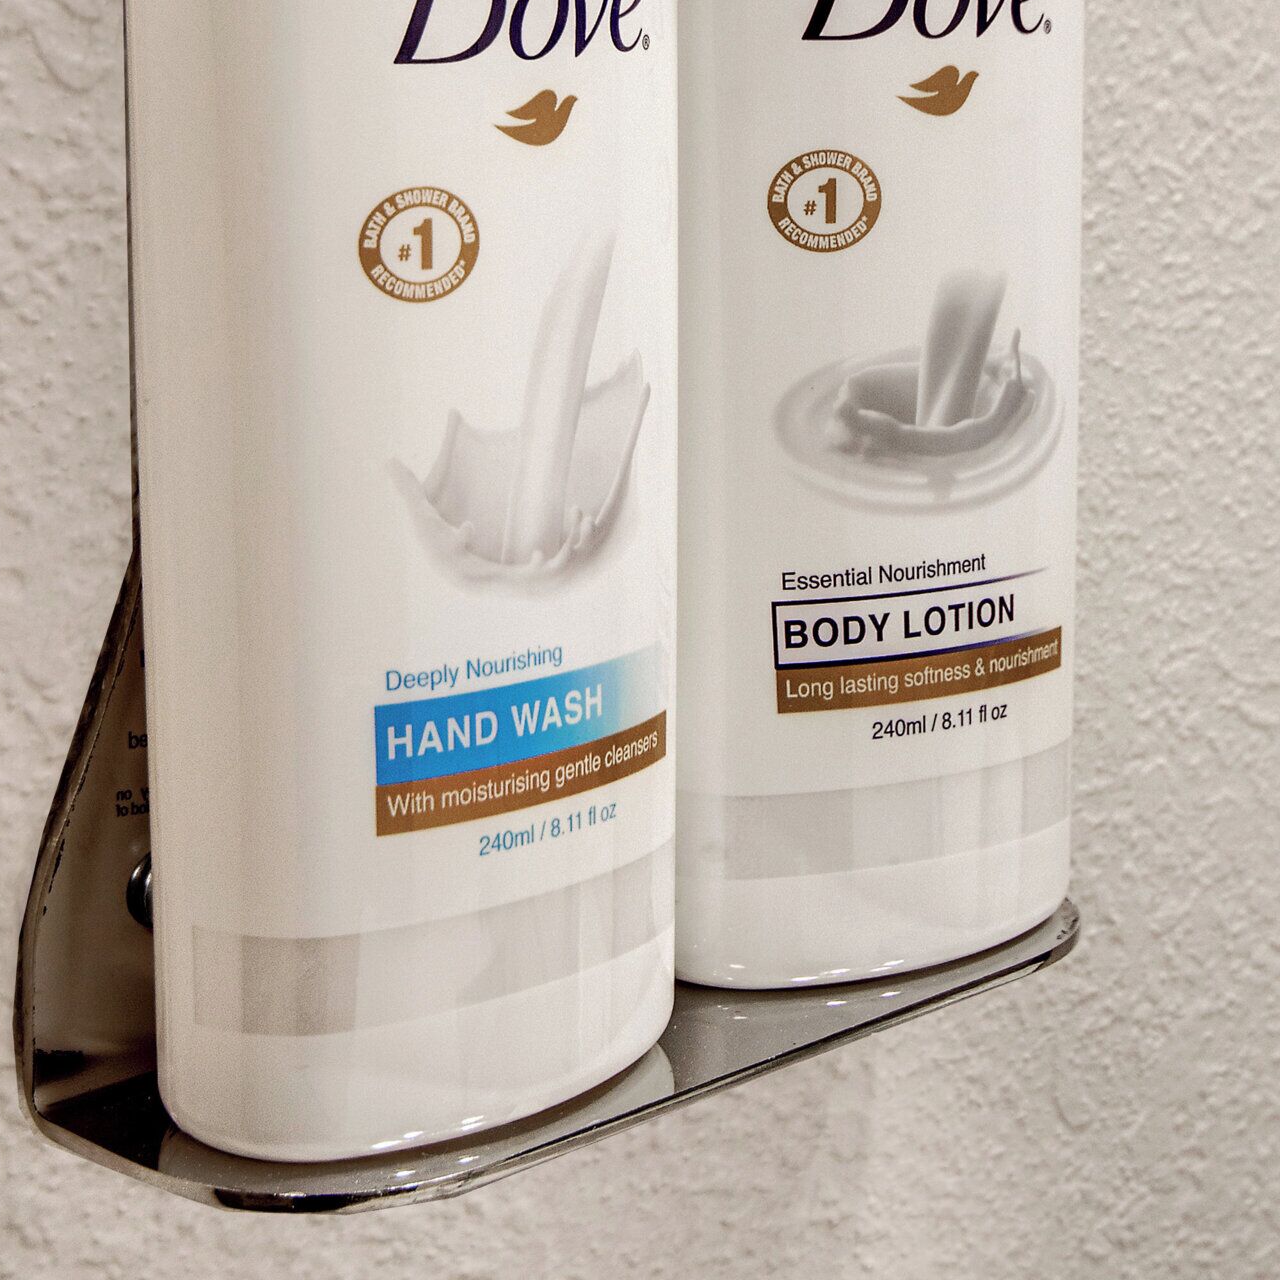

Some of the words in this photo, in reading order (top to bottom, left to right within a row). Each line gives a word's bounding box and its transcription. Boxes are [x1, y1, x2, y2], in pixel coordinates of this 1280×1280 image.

[771, 171, 794, 203] BATH
[791, 162, 803, 175] &
[801, 152, 853, 169] SHOWER
[851, 161, 878, 202] BRAND
[363, 211, 388, 248] BATH
[383, 202, 397, 217] &
[395, 189, 449, 209] SHOWER
[447, 199, 476, 244] BRAND
[781, 566, 872, 591] Essential
[879, 553, 987, 584] Nourishment
[784, 612, 890, 650] BODY
[904, 593, 1015, 639] LOTION
[385, 664, 459, 691] Deeply
[467, 645, 563, 680] Nourishing
[785, 678, 834, 701] Long
[840, 671, 898, 694] lasting
[904, 661, 971, 687] softness
[974, 658, 986, 677] &
[989, 638, 1058, 674] nourishment
[387, 710, 498, 761] HAND
[511, 684, 603, 737] WASH
[872, 715, 926, 740] 240ml
[931, 713, 938, 733] /
[942, 708, 973, 730] 8.11
[978, 704, 987, 723] fl
[991, 703, 1007, 721] oz
[387, 790, 434, 818] With
[441, 768, 551, 810] moisturising
[555, 752, 601, 789] gentle
[605, 729, 658, 766] cleansers
[479, 825, 535, 856] 240ml
[540, 821, 547, 842] /
[550, 814, 583, 837] 8.11
[588, 806, 596, 826] fl
[600, 802, 617, 822] oz
